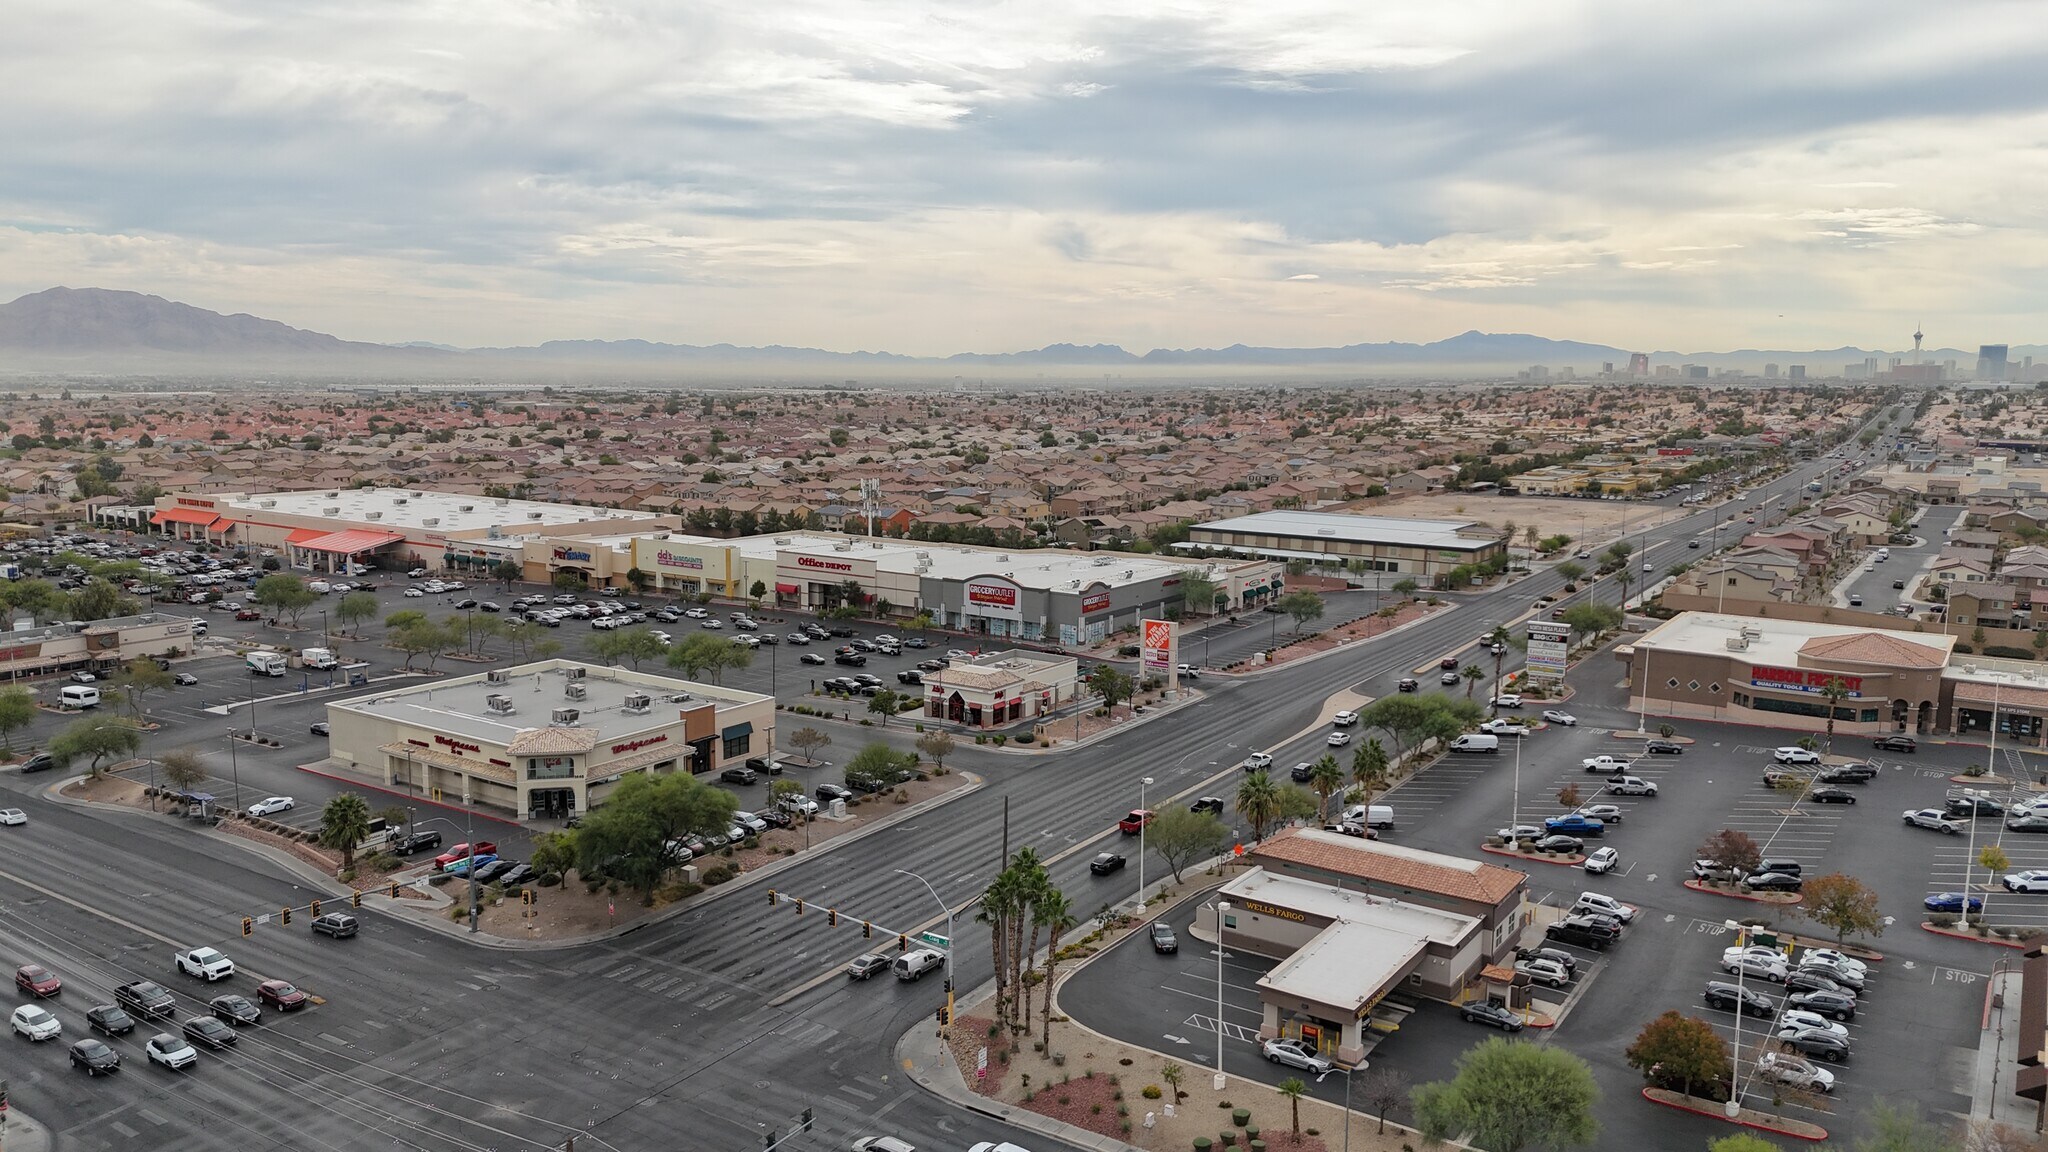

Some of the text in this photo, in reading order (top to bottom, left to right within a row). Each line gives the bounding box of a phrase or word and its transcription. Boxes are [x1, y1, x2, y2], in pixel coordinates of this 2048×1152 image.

[657, 549, 672, 560] dd's
[798, 557, 852, 571] Office DEPOT
[1146, 623, 1170, 648] HOME
[1148, 625, 1159, 635] THE
[1155, 633, 1170, 649] DEPOT
[1752, 666, 1803, 684] HARBOR
[434, 735, 480, 753] Walgreens
[611, 734, 668, 754] Walgreens
[1923, 770, 1945, 779] STOP
[1246, 902, 1305, 921] WELLS FARGO
[1697, 922, 1727, 937] STOP
[928, 935, 940, 944] Craig
[1945, 970, 1976, 984] STOP
